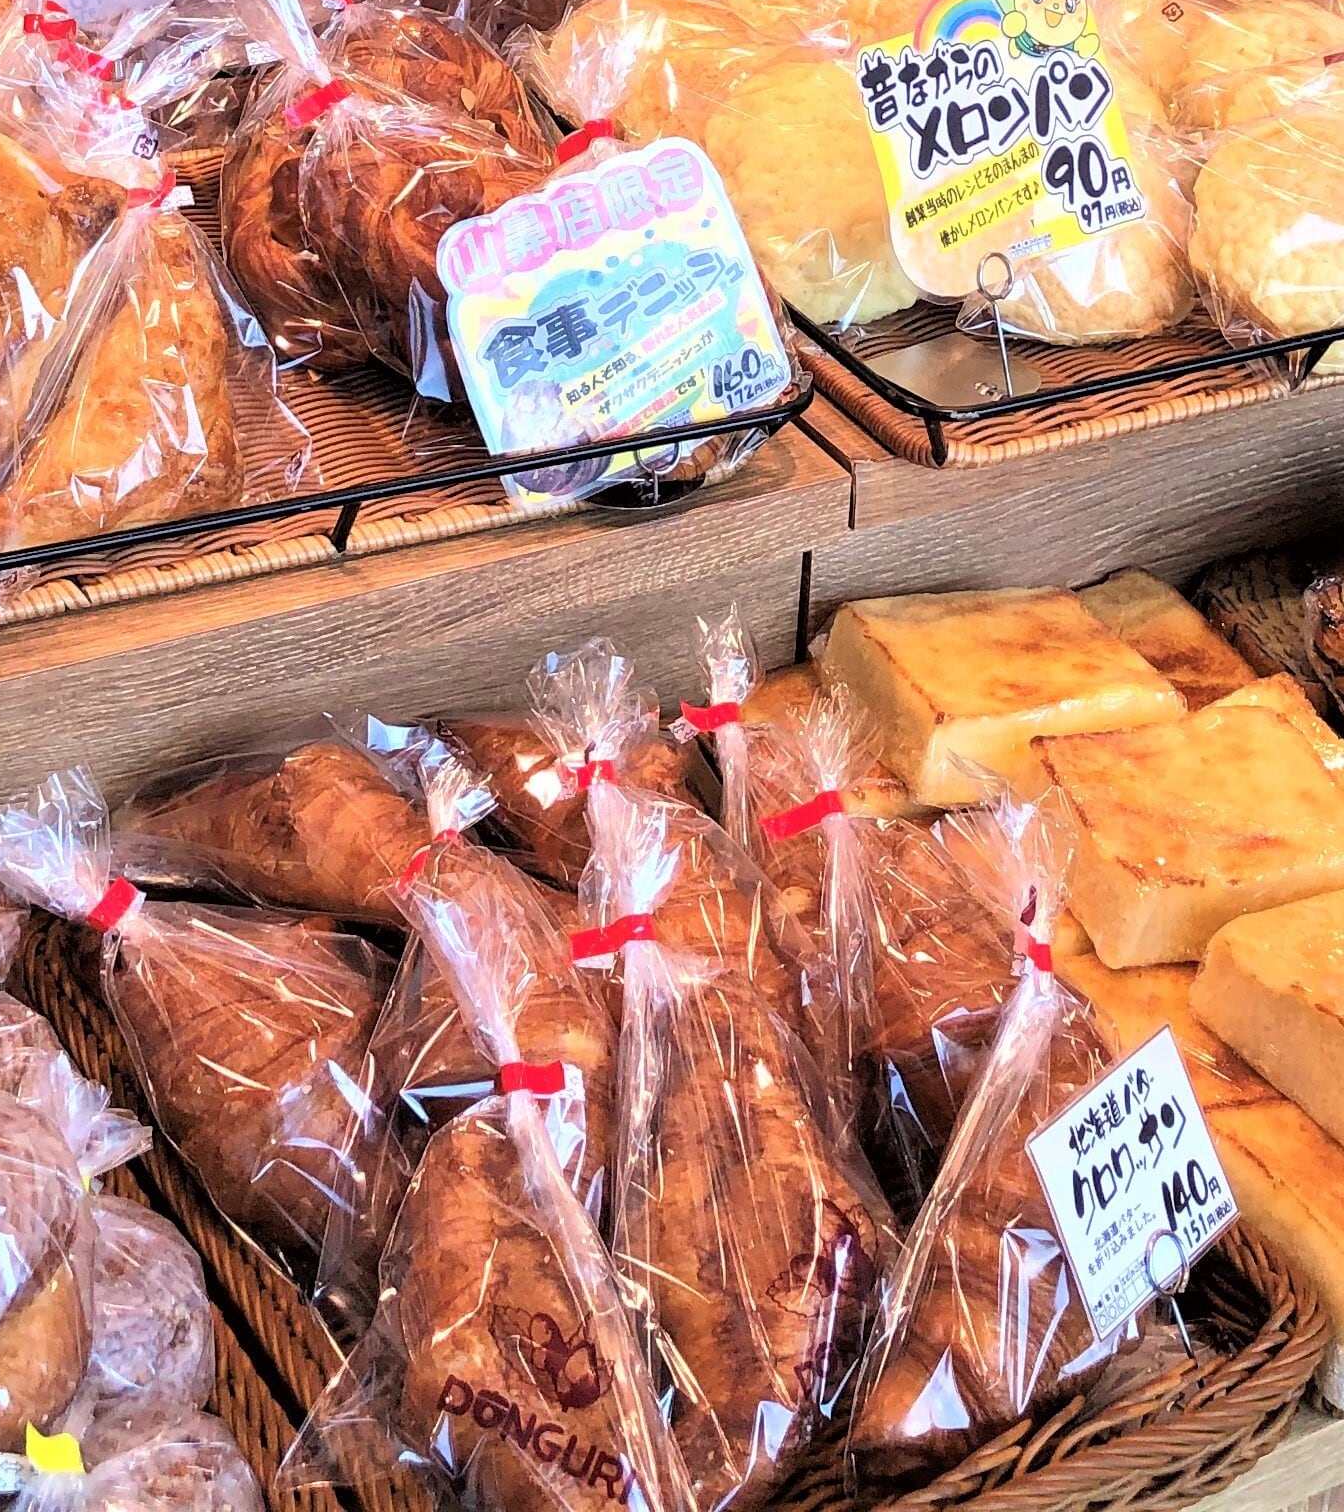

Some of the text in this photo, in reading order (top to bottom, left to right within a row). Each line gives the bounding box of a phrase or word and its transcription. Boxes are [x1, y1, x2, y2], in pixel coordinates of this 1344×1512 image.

[861, 46, 999, 127] 昔ながらの
[906, 59, 1111, 173] メロンパン
[451, 152, 704, 288] 山鼻店限定
[1045, 140, 1132, 205] 90円
[484, 251, 746, 388] 食事デニッシュ
[712, 348, 774, 399] 160円
[1069, 1067, 1155, 1165] 北海道バター
[1072, 1094, 1187, 1236] クロワッサン
[1161, 1158, 1223, 1232] 140円
[436, 1373, 637, 1505] DONGURI
